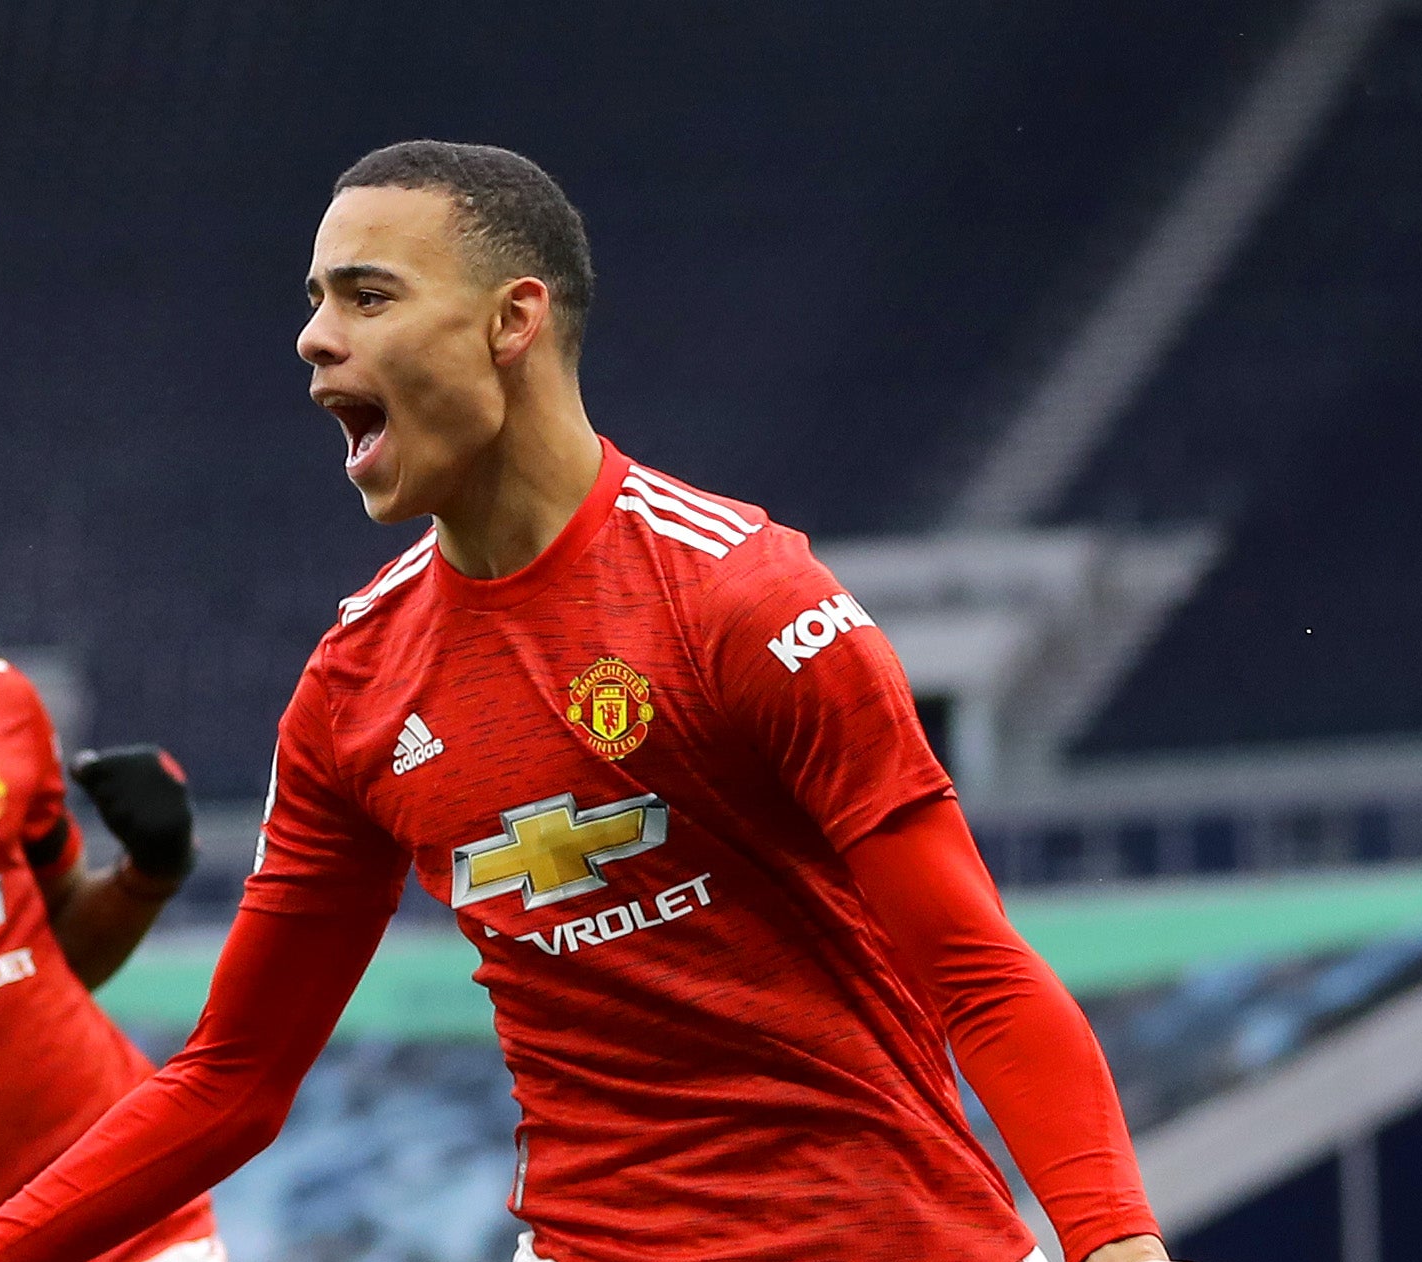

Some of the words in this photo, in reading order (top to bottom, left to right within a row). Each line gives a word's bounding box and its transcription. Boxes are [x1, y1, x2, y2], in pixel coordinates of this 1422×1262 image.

[575, 665, 646, 698] MANCHESTER
[392, 738, 445, 775] adidas
[587, 735, 638, 754] UNITED
